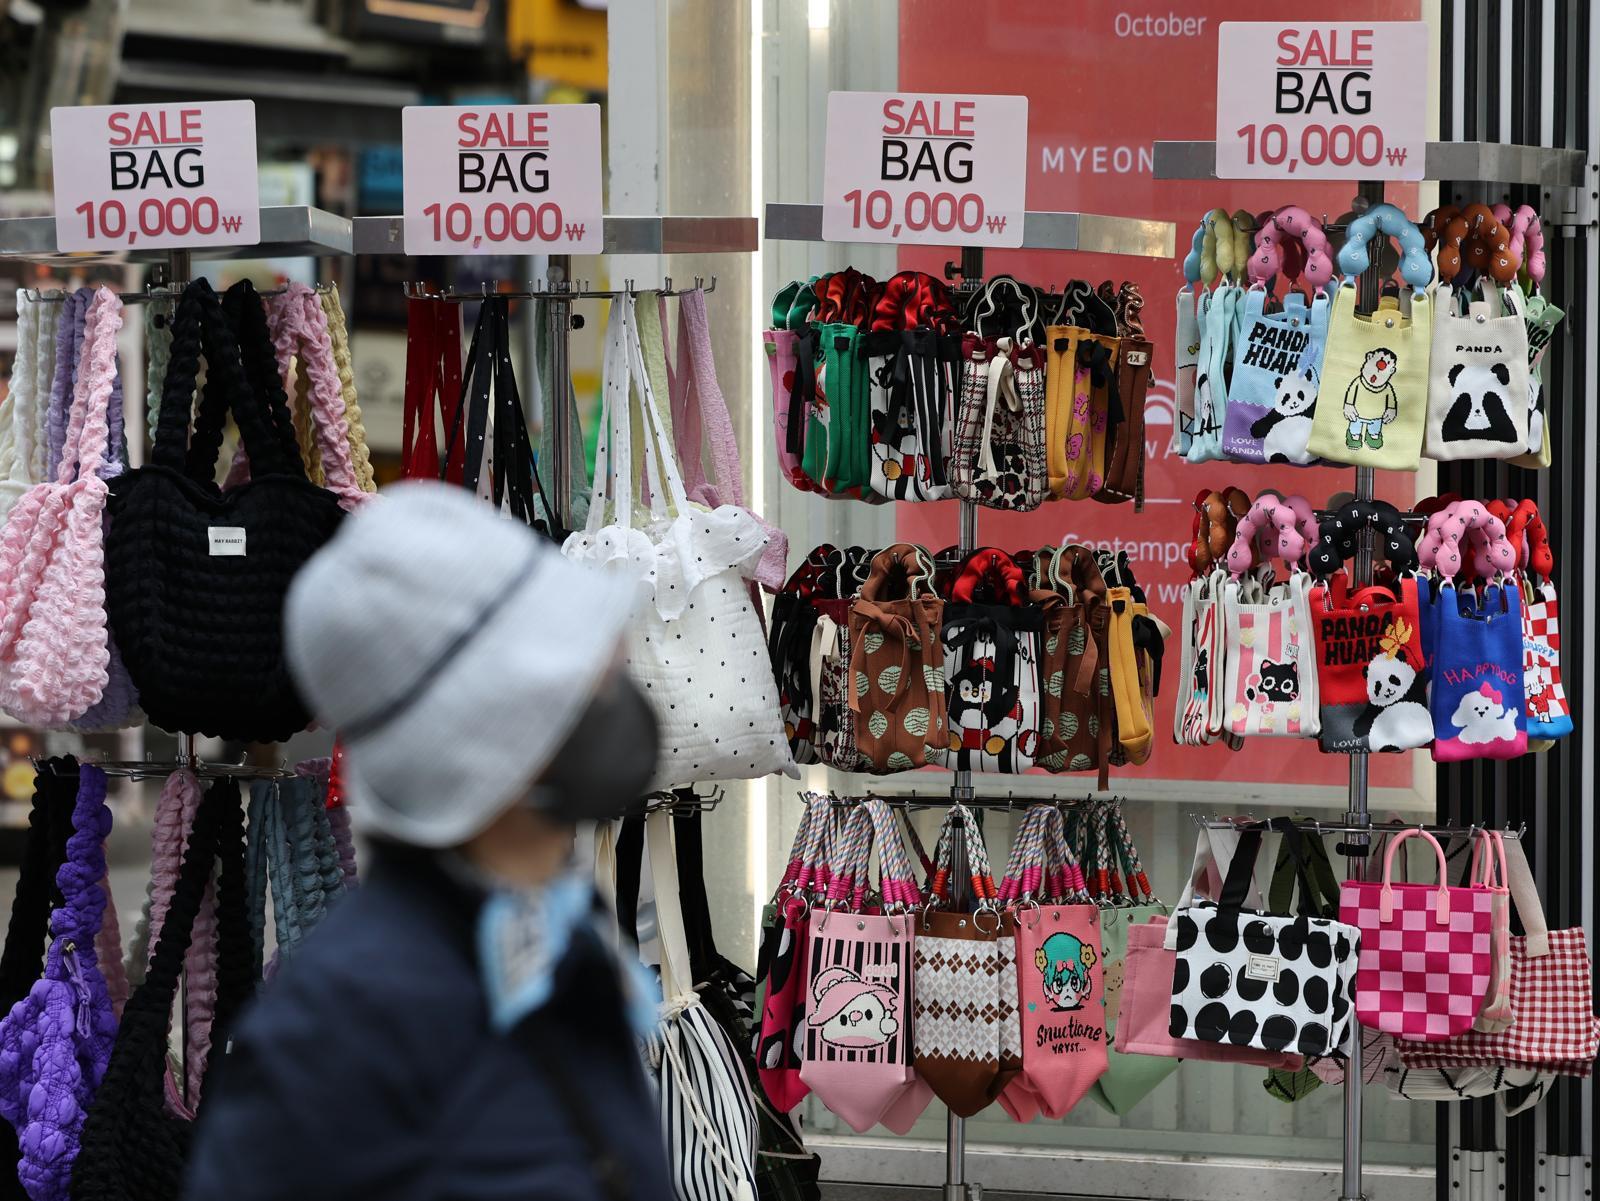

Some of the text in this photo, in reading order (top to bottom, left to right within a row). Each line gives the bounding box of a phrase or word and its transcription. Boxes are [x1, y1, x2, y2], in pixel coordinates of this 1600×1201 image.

[1114, 11, 1207, 38] October
[1276, 28, 1374, 66] SALE
[1275, 71, 1372, 115] BAG
[107, 109, 203, 146] SALE
[457, 112, 549, 148] SALE
[882, 98, 976, 137] SALE
[109, 148, 204, 191] BAG
[458, 151, 549, 193] BAG
[880, 139, 974, 184] BAG
[1041, 146, 1154, 174] MYEON
[1455, 345, 1503, 354] PANDA
[1223, 445, 1264, 456] PANDA
[1230, 436, 1257, 446] LOVE
[1322, 611, 1393, 641] PANDA
[1325, 637, 1382, 666] HUAH
[1333, 738, 1362, 749] LOVE
